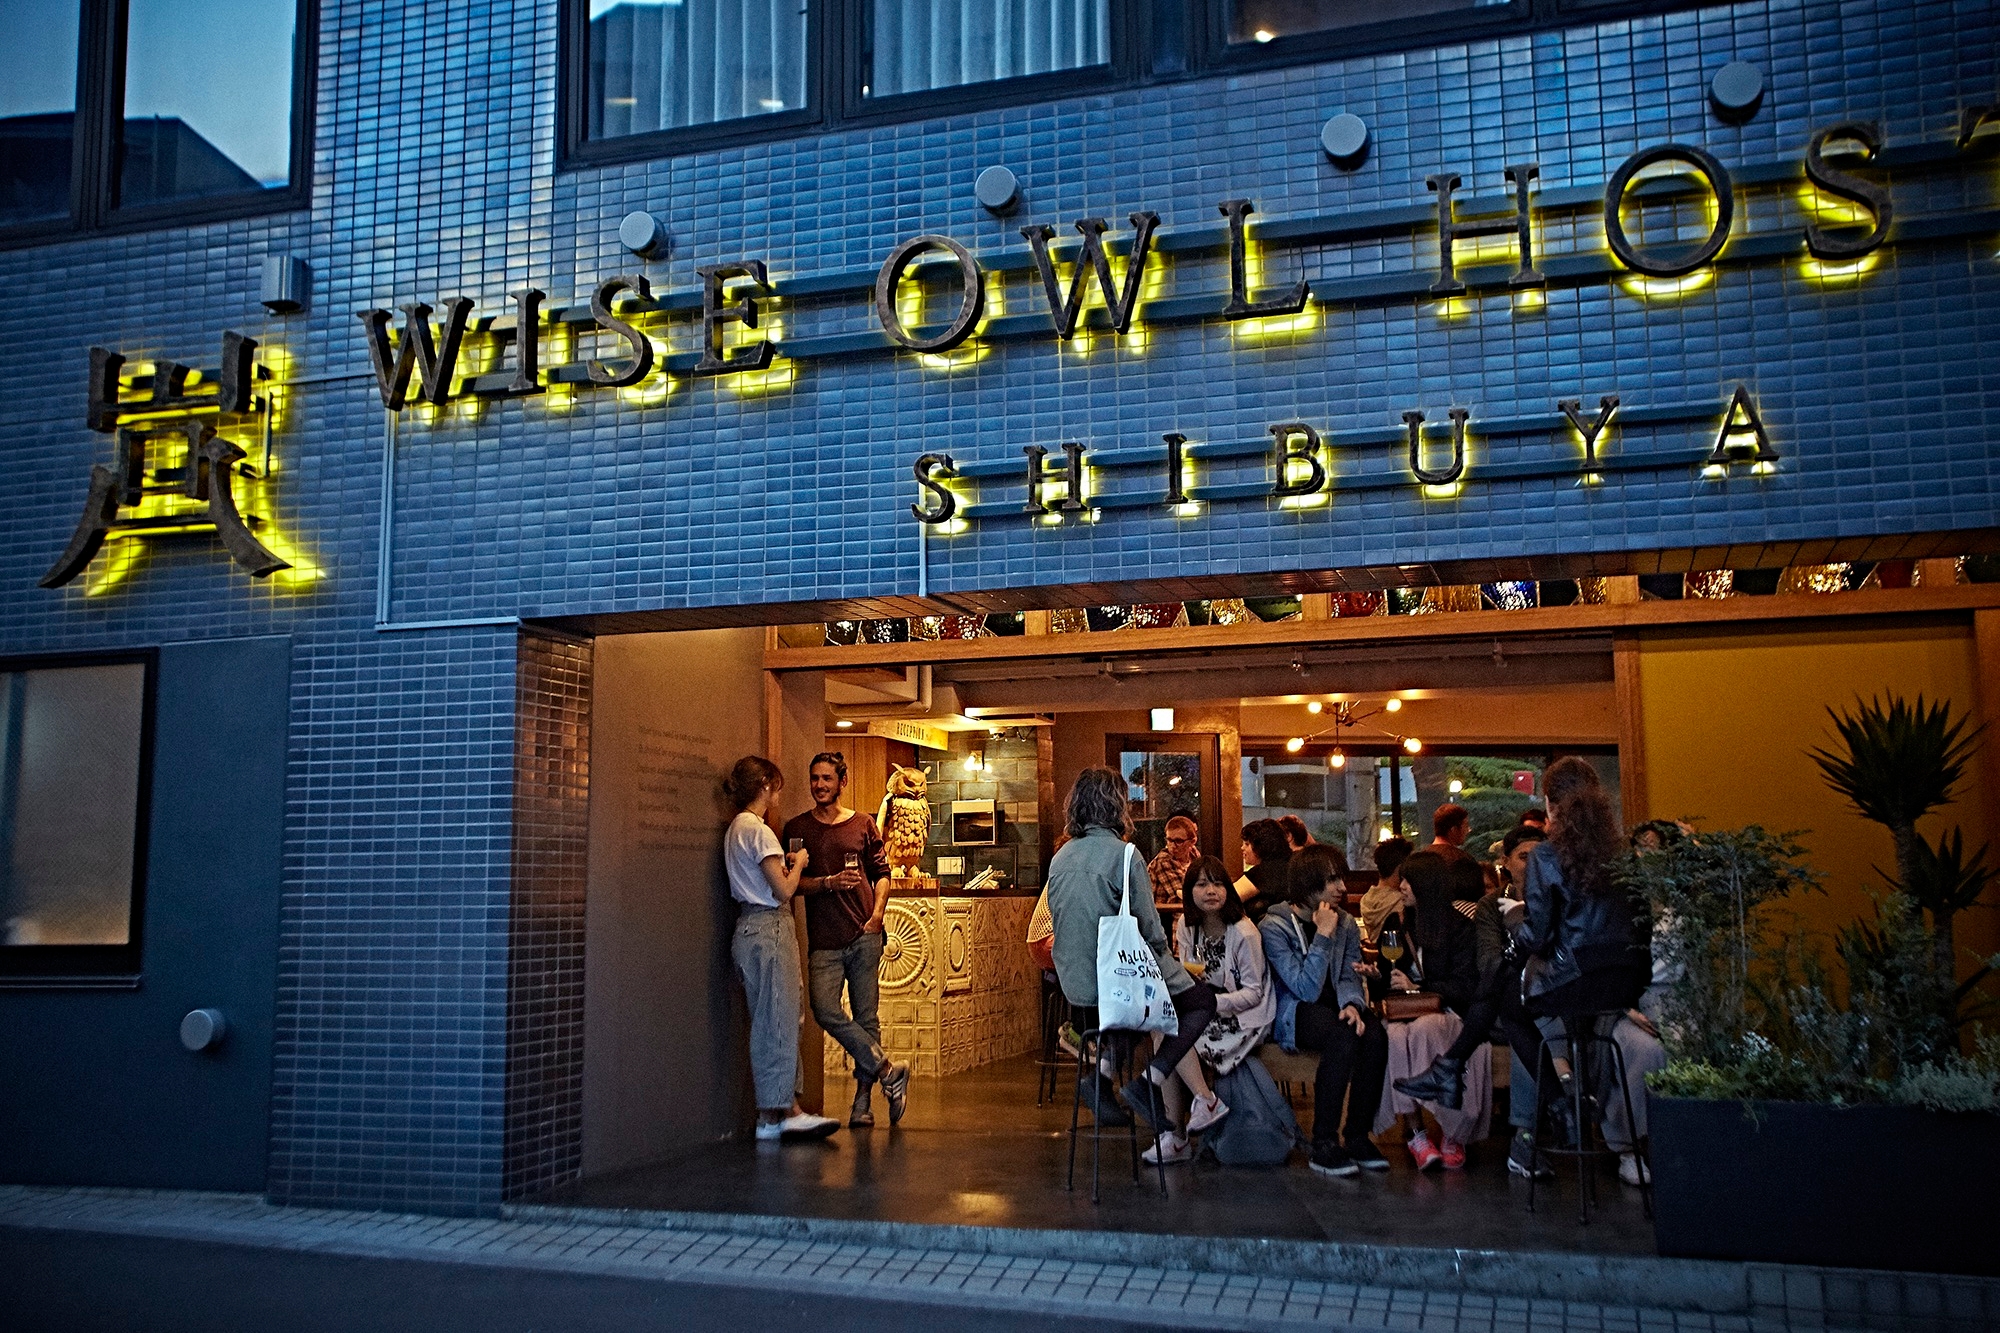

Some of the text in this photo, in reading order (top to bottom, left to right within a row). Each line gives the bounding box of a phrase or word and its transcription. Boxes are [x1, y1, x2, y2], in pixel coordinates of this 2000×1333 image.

[357, 259, 777, 412] WISE
[875, 198, 1311, 354] OWL
[911, 384, 1780, 524] SHIBUYA
